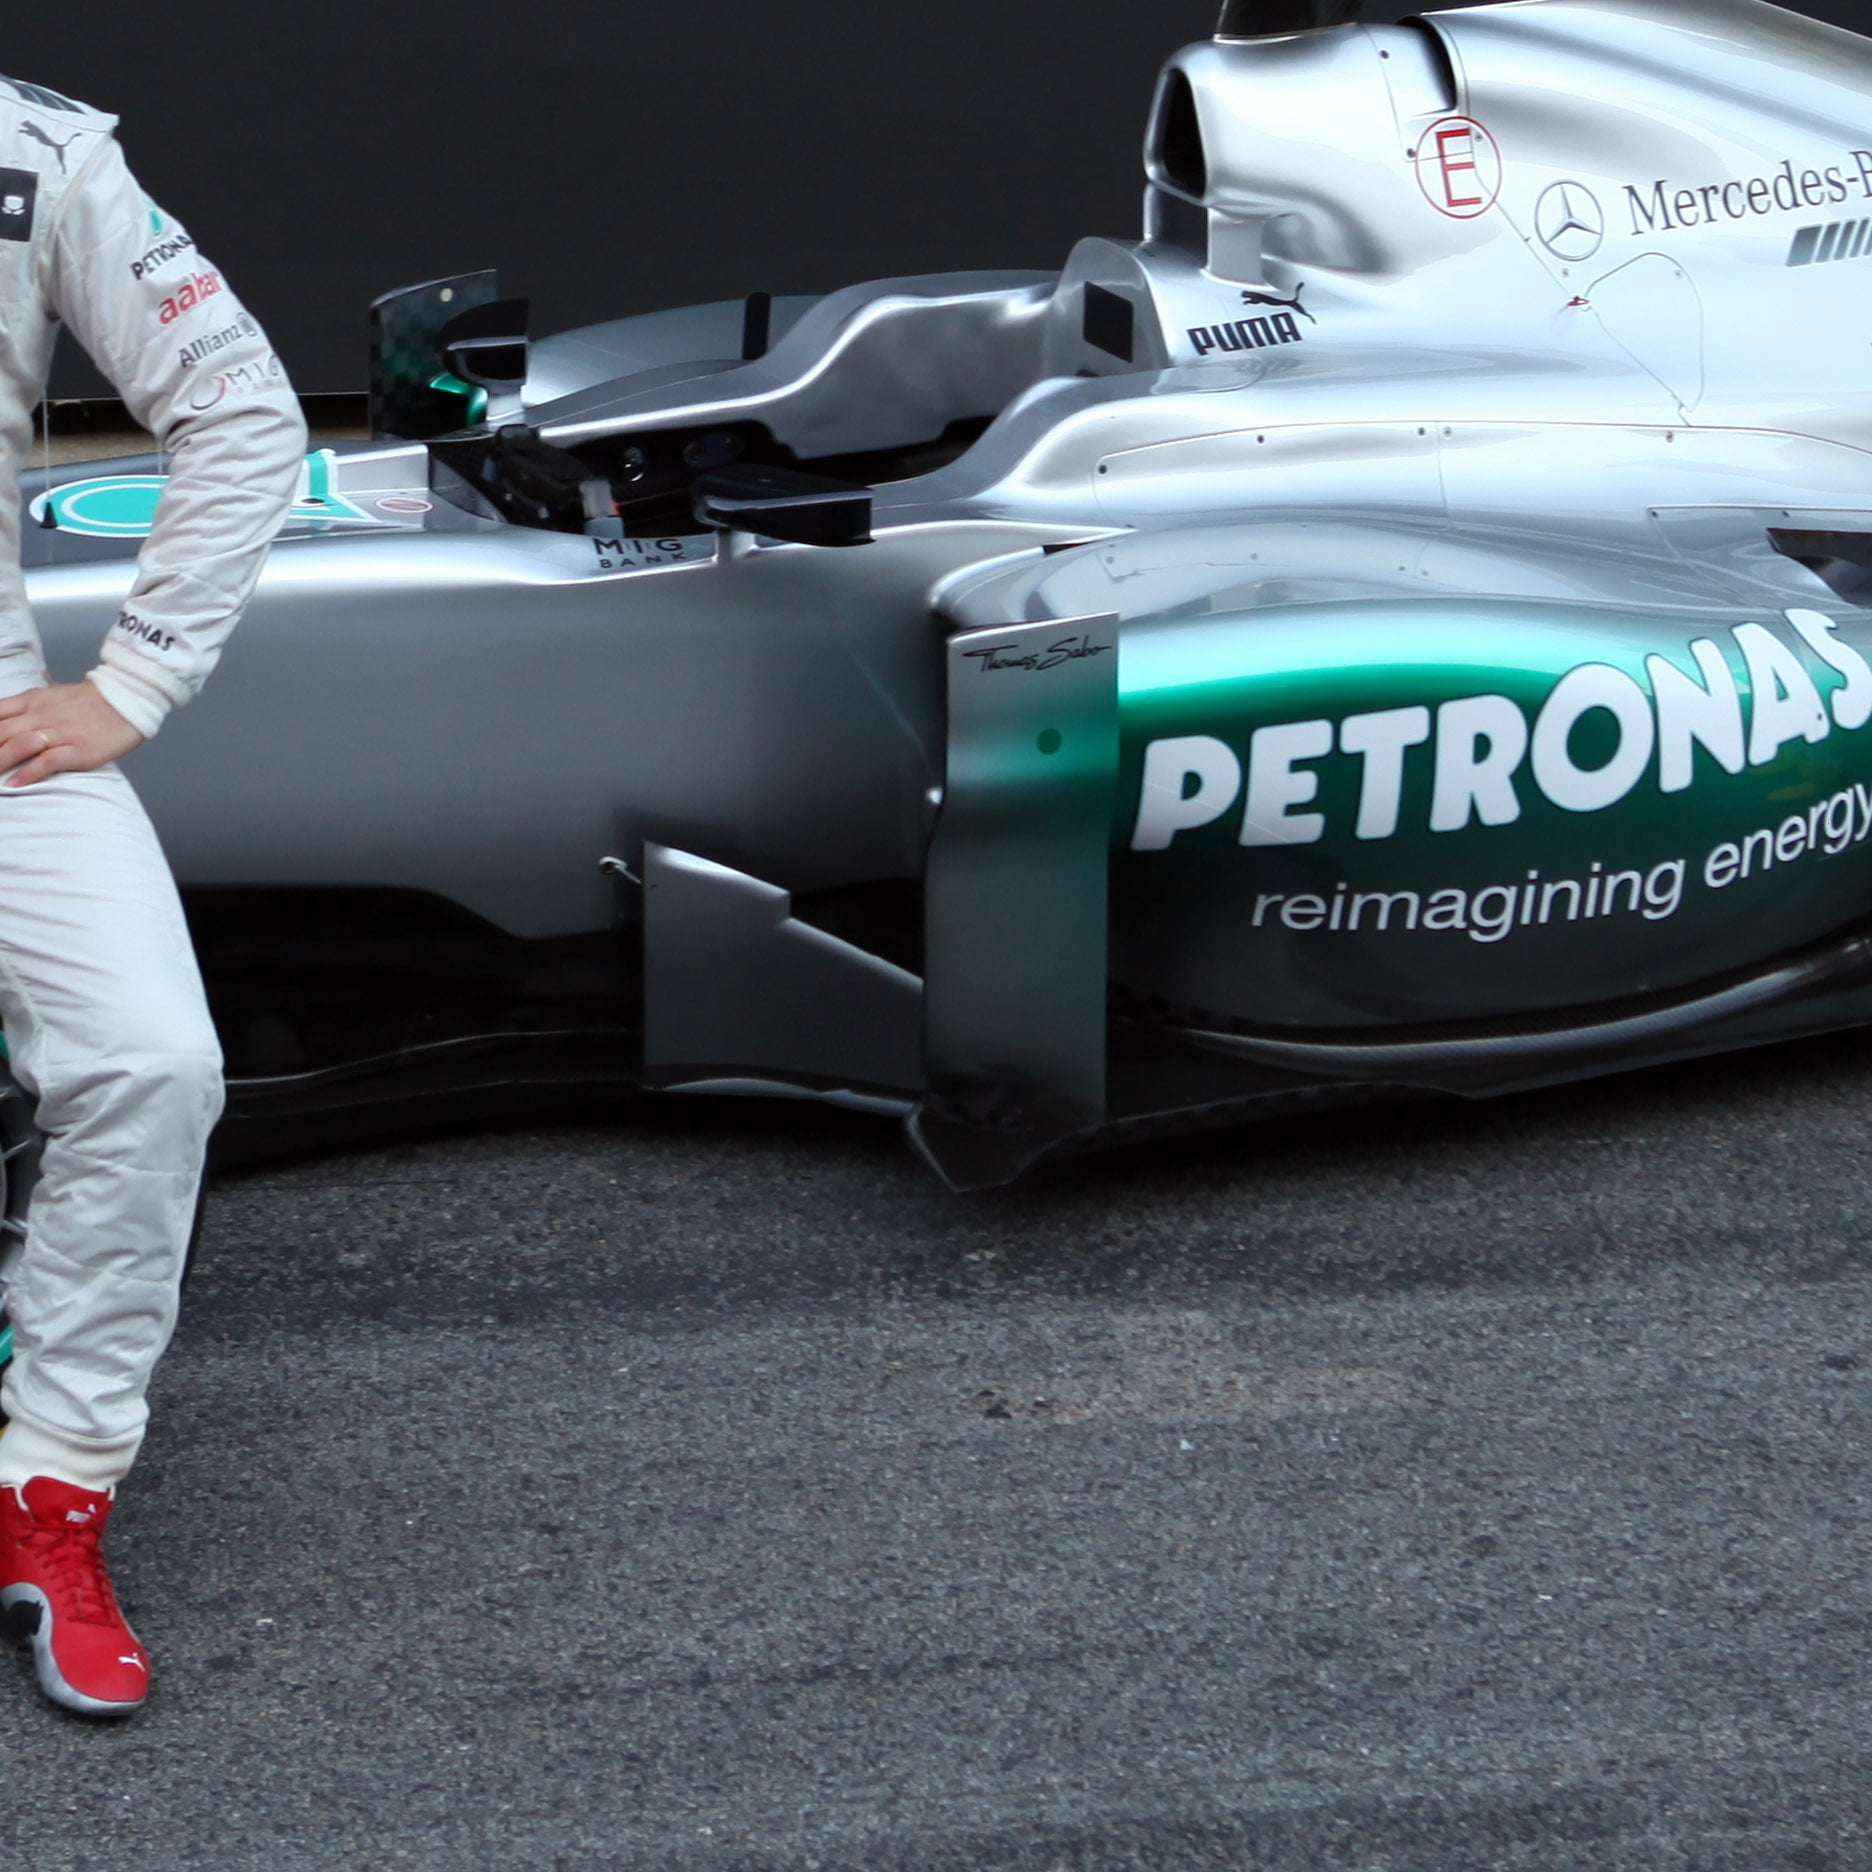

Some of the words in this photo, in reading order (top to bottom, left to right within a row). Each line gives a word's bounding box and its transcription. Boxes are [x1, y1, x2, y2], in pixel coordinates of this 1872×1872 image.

[1436, 127, 1483, 208] E
[130, 234, 194, 280] PETRONA
[178, 325, 243, 368] Allianz
[1187, 312, 1302, 356] PUMA
[592, 537, 683, 555] MIG
[599, 552, 686, 568] BANK
[1252, 858, 1686, 943] reimagining
